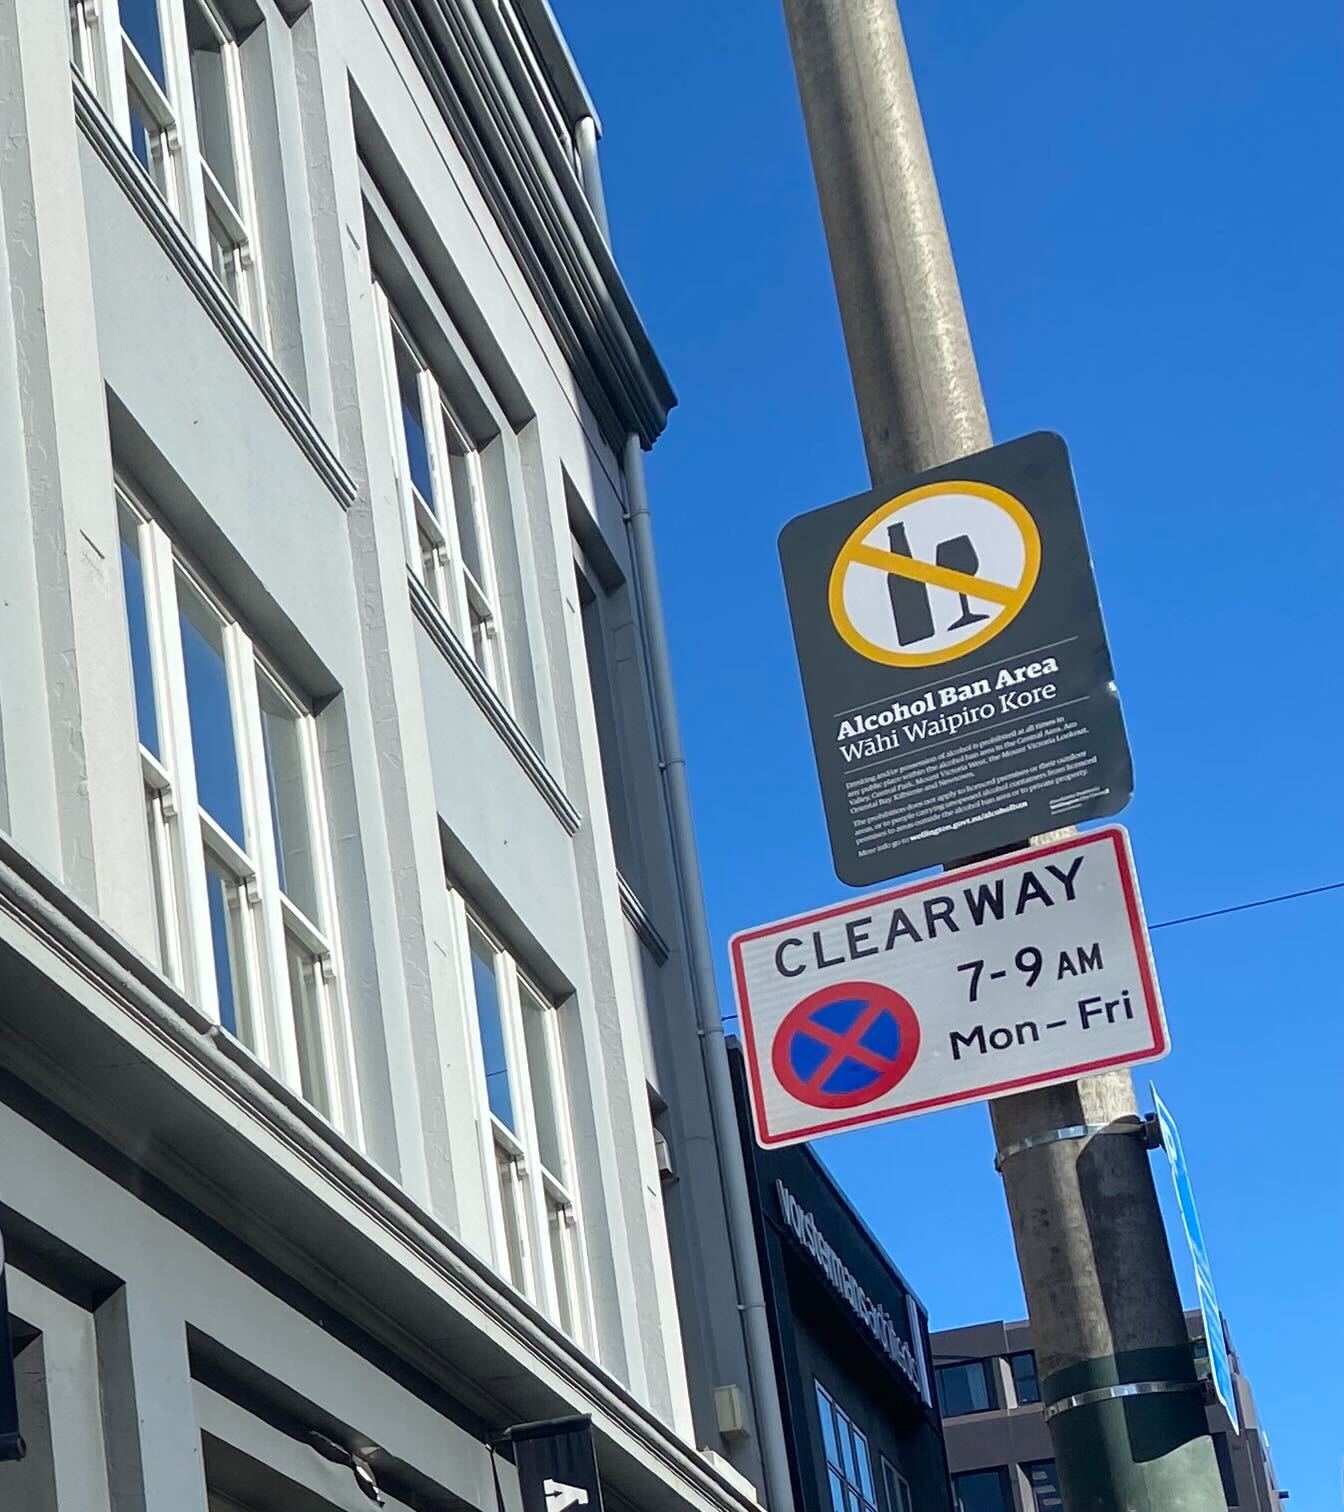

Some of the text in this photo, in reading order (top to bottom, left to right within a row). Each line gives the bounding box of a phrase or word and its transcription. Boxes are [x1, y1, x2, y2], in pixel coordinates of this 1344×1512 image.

[837, 657, 1059, 741] Alcohol Ban Area
[840, 682, 1057, 763] Wāhi Waipiro Kore
[774, 856, 1085, 978] CLEARWAY
[957, 942, 1104, 1002] 7-9 AM
